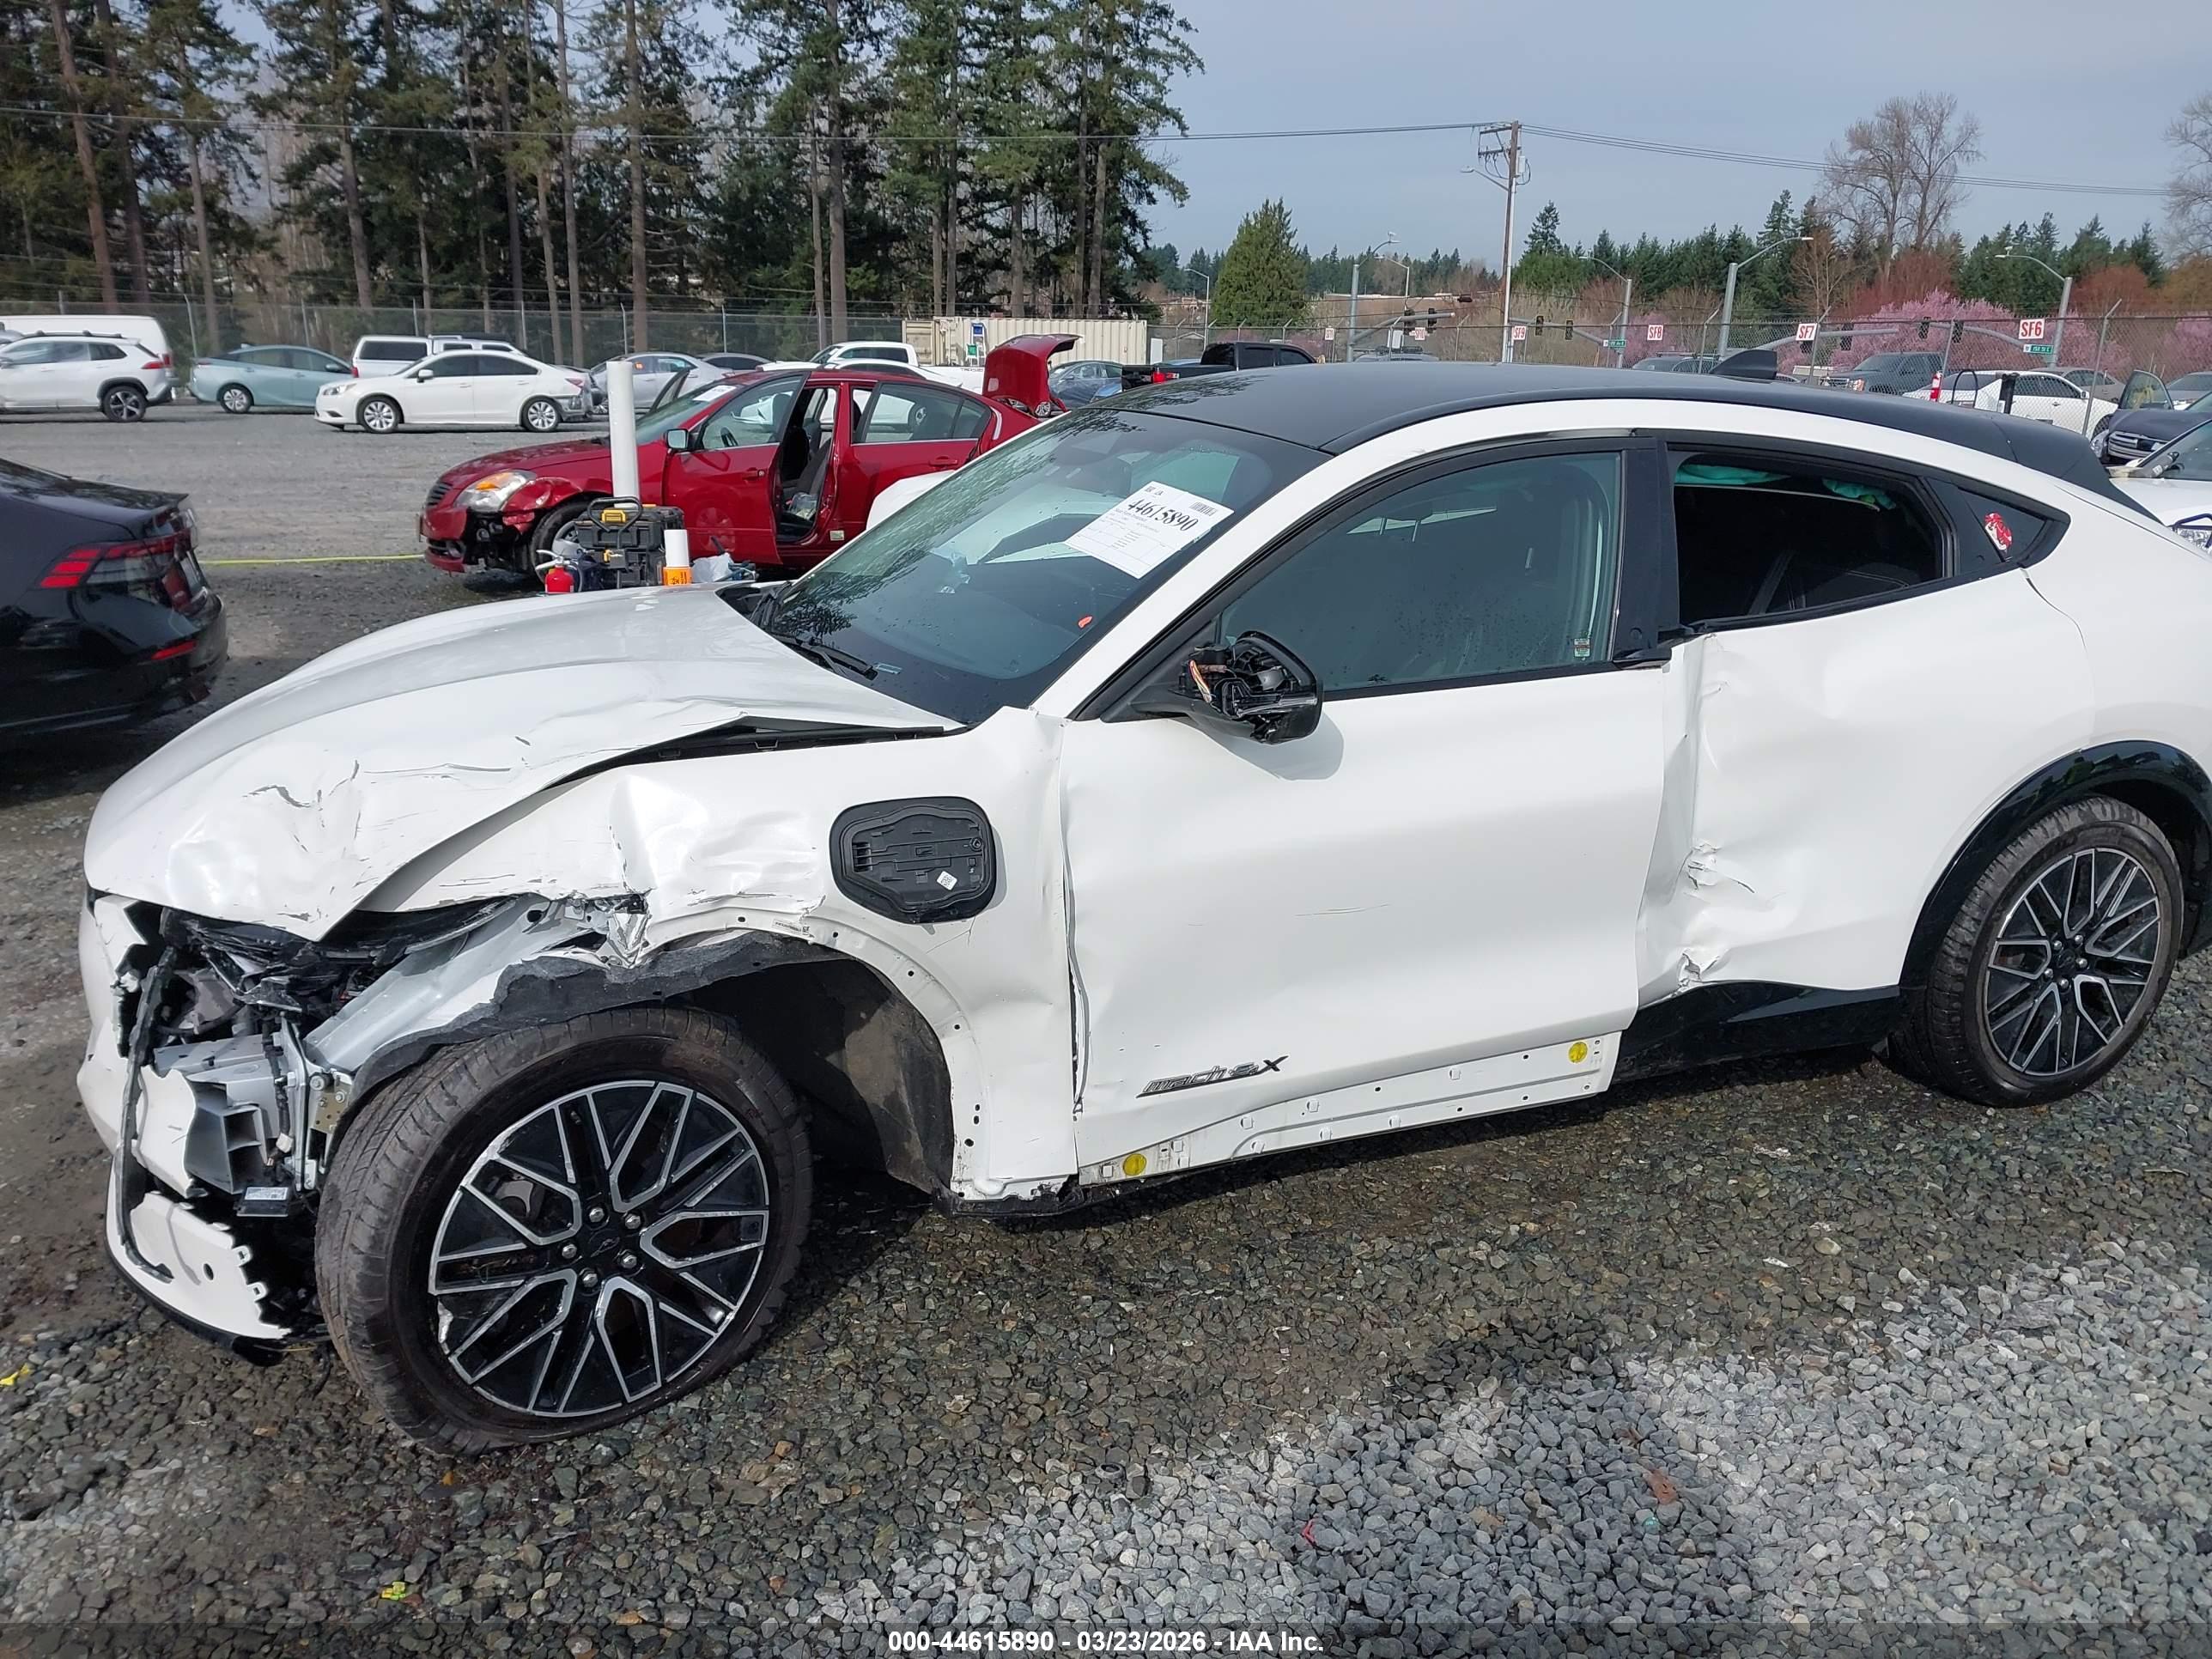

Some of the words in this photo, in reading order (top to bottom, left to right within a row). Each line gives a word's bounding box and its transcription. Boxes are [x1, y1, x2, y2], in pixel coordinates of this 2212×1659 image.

[1798, 325, 1814, 339] SF7
[2021, 321, 2042, 337] SF6
[1127, 498, 1199, 532] 44615890
